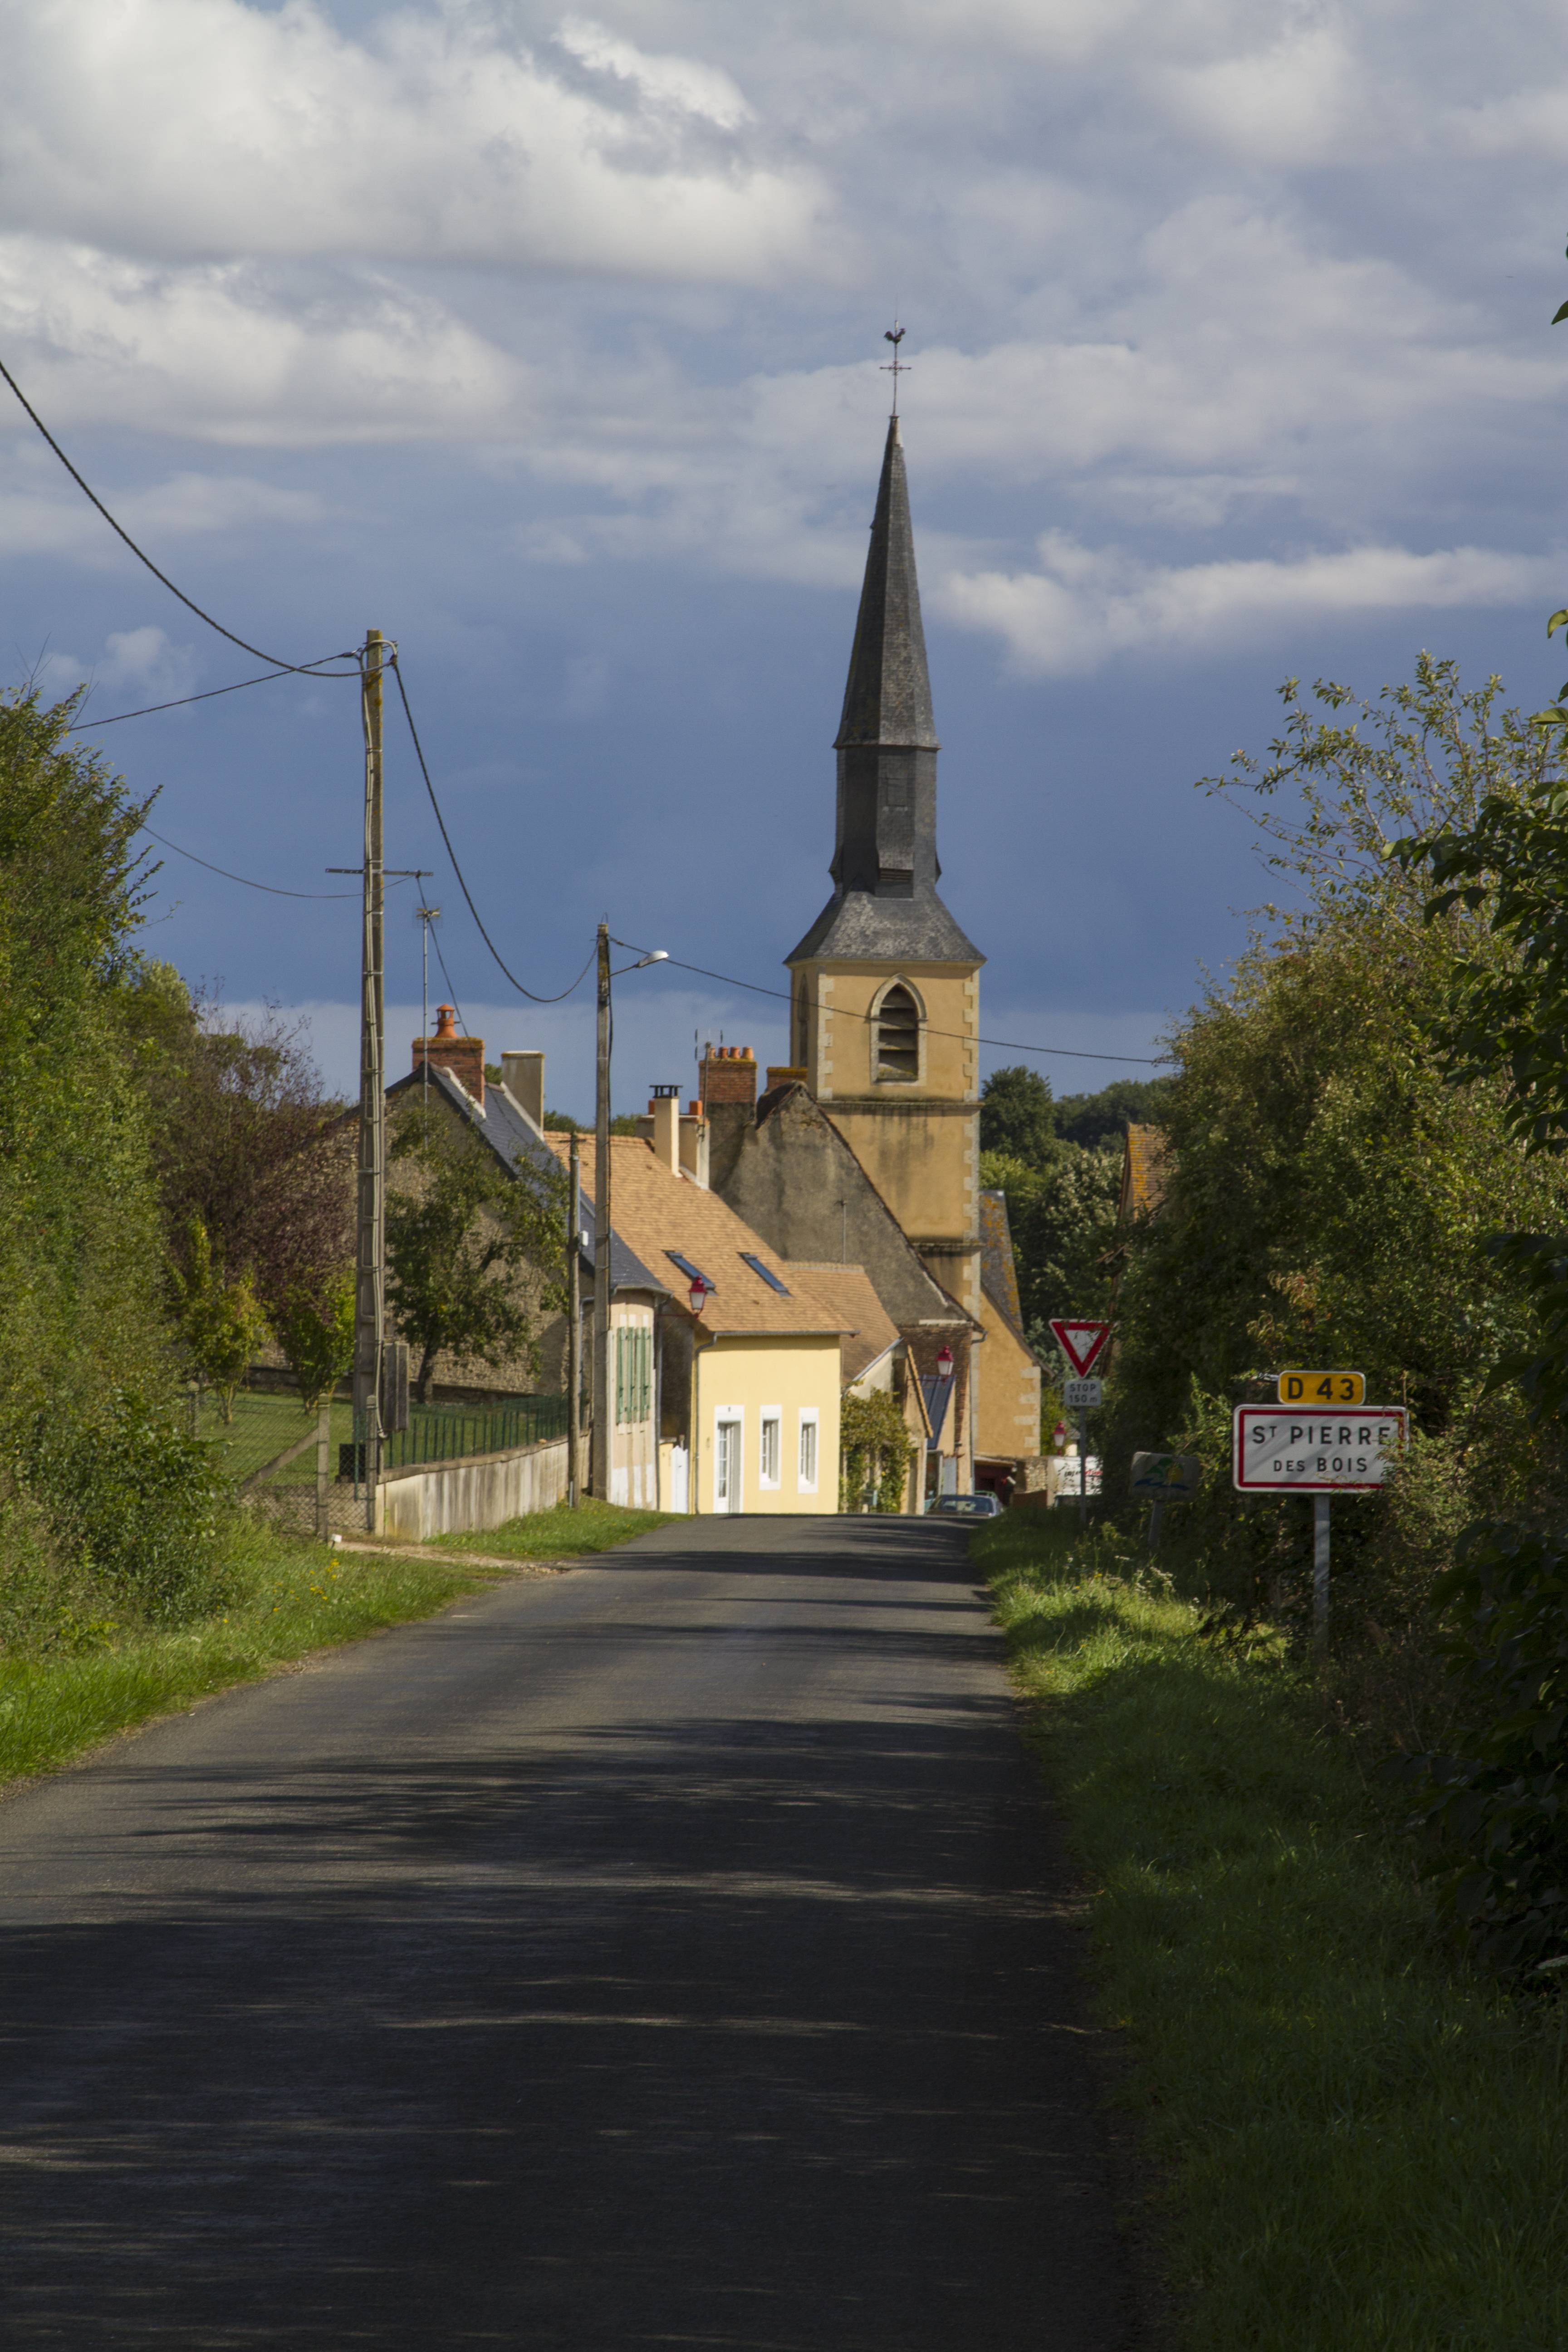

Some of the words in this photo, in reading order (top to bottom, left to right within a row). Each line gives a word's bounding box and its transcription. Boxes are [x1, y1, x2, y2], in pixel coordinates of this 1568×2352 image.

[1069, 1384, 1096, 1392] STOP
[1288, 1377, 1303, 1399] D
[1317, 1377, 1354, 1400] 43
[1069, 1394, 1088, 1403] 150
[1290, 1426, 1390, 1445] PIERRE
[1274, 1460, 1305, 1472] DES
[1317, 1457, 1367, 1472] BOIS
